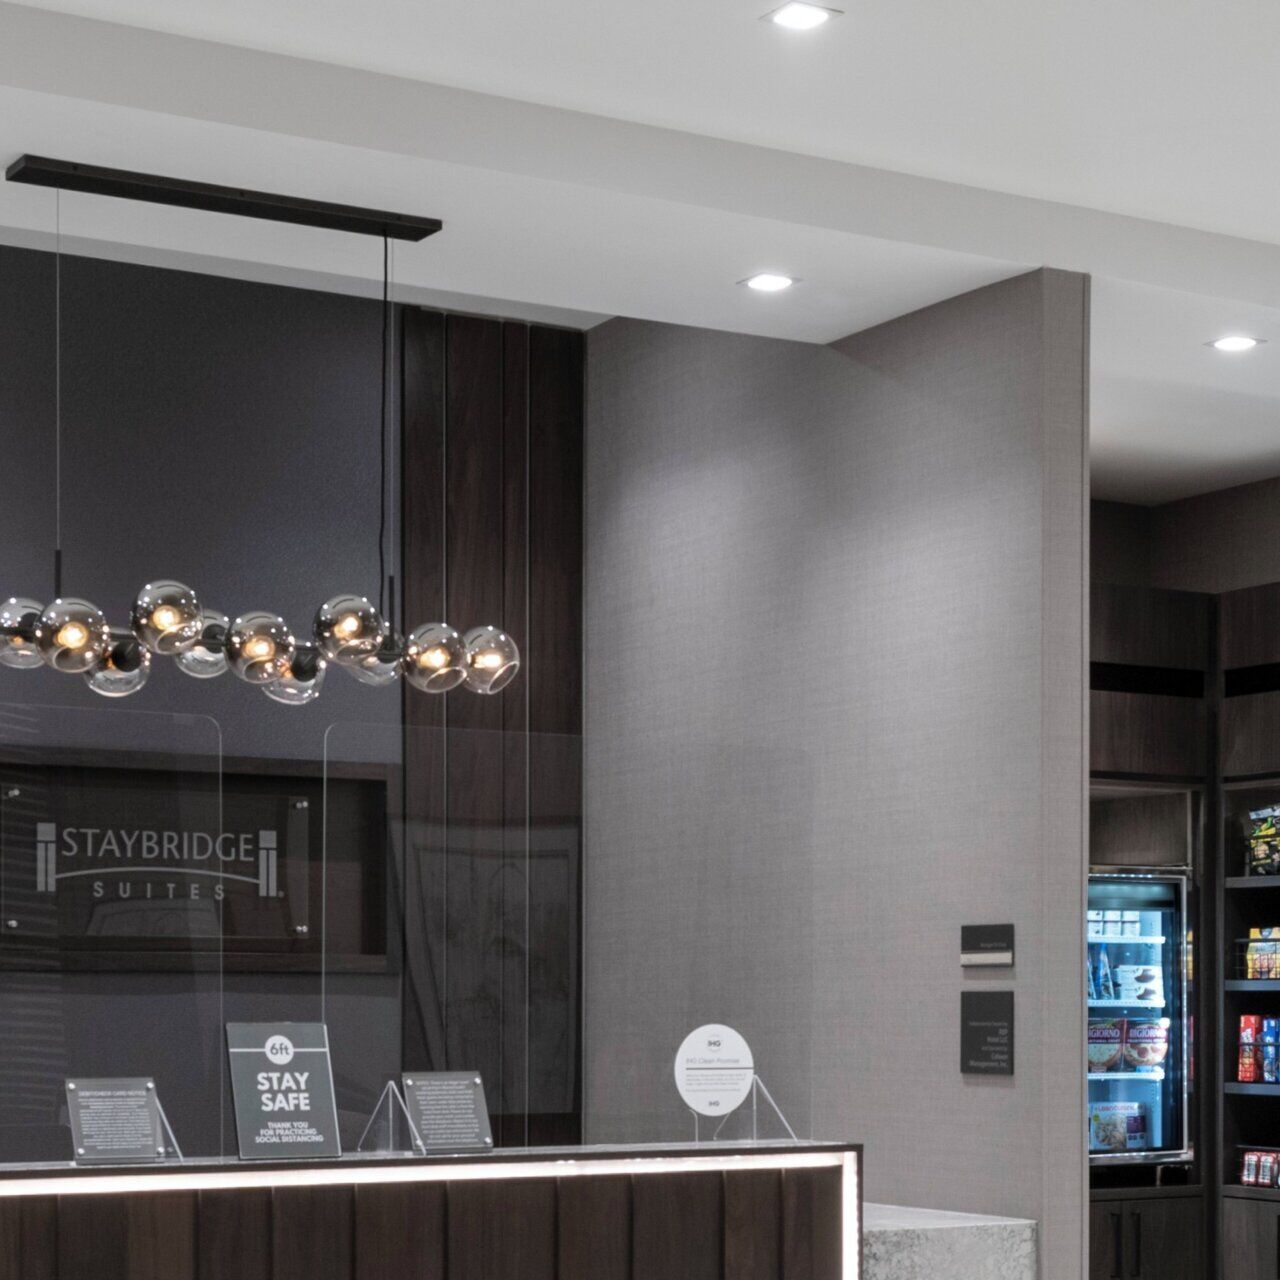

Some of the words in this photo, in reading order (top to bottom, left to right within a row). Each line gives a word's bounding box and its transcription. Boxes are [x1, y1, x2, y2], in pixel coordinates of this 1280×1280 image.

[61, 828, 255, 862] STAYBRIDGE
[92, 881, 225, 900] SUITES
[1089, 1029, 1120, 1038] IGIORNO
[270, 1043, 290, 1055] 6ft
[257, 1072, 310, 1091] STAY
[261, 1092, 311, 1111] SAFE
[267, 1121, 291, 1129] THANK
[293, 1121, 308, 1129] YOU
